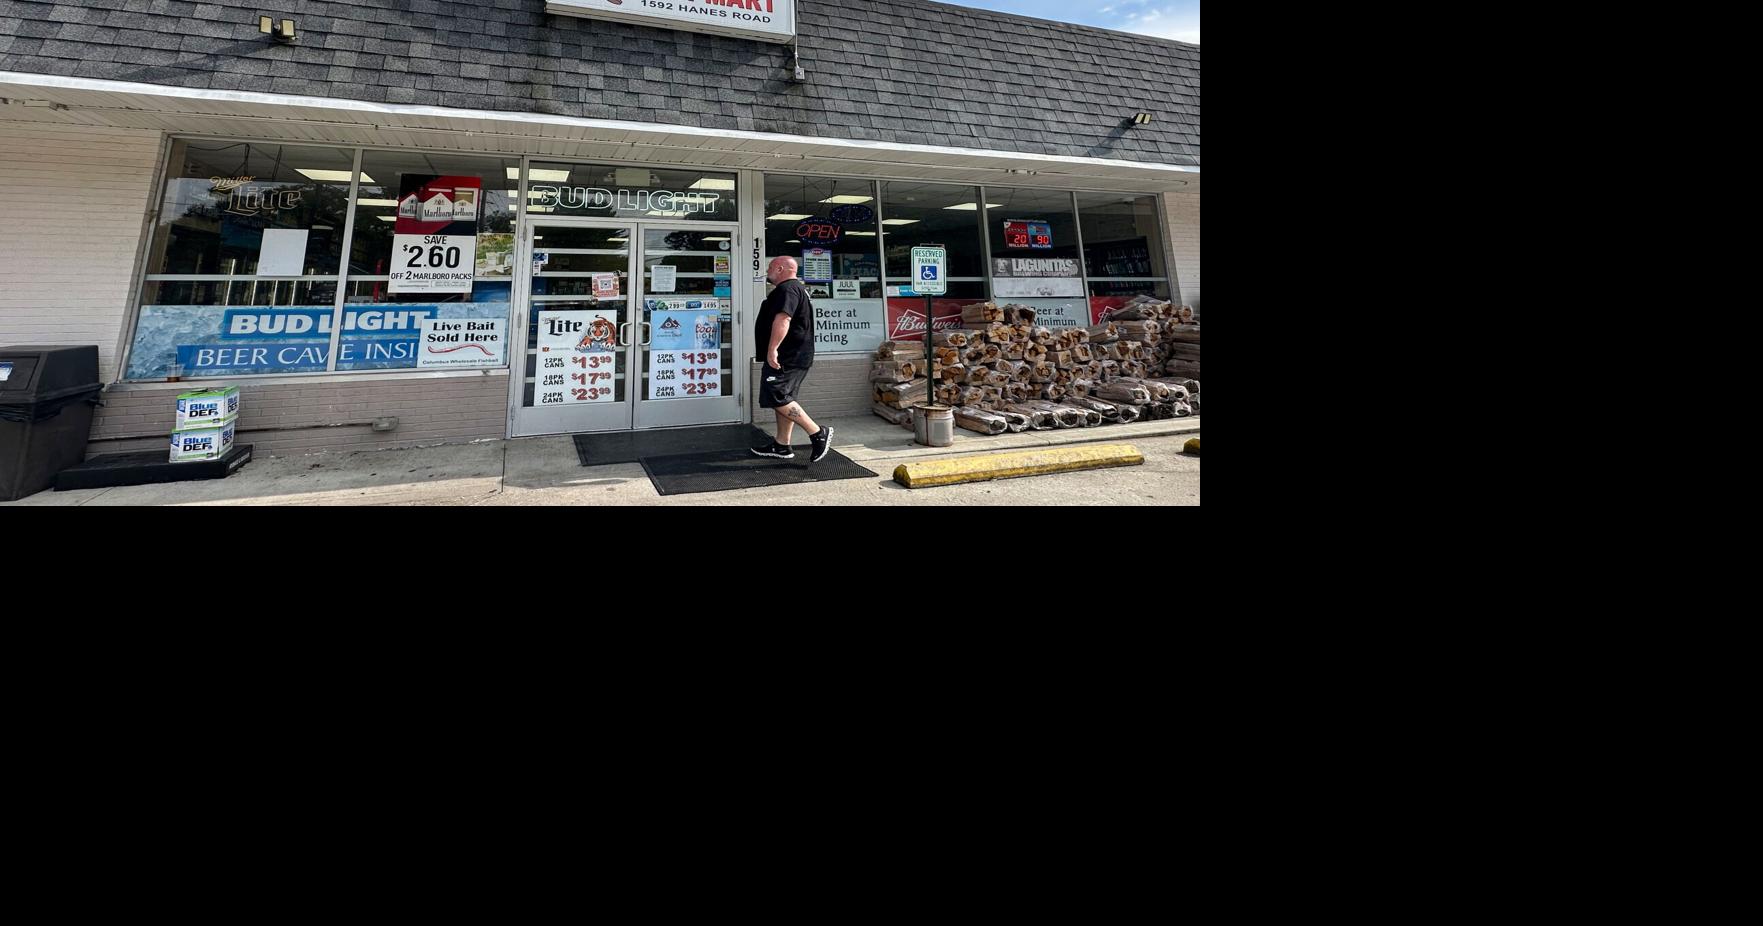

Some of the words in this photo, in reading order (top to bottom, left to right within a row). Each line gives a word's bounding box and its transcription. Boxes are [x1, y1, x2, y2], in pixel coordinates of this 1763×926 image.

[640, 0, 674, 10] 1592
[678, 4, 727, 18] HANES
[732, 12, 771, 23] ROAD
[704, 0, 774, 13] ART
[224, 187, 302, 217] Lite
[531, 185, 613, 209] BUD
[617, 189, 720, 213] LIGHT
[796, 224, 841, 239] OPEN
[424, 236, 448, 245] SAVE
[1013, 234, 1027, 244] 20
[1036, 235, 1050, 244] 90
[402, 245, 461, 269] $2.60
[914, 250, 943, 258] RESERVED
[918, 257, 940, 265] PARKING
[1011, 258, 1074, 272] LAGUNITAS
[405, 271, 411, 280] 2
[451, 272, 472, 280] PACKS
[839, 281, 855, 289] JUUL
[815, 308, 842, 319] Beer
[846, 308, 857, 318] at
[1054, 307, 1064, 316] at
[229, 314, 314, 334] BUD
[433, 322, 462, 332] Live
[467, 321, 495, 331] Bait
[816, 320, 871, 331] Minimum
[1033, 317, 1077, 327] Minimum
[548, 320, 583, 337] Lite
[427, 333, 459, 343] Sold
[465, 333, 499, 343] Here
[814, 333, 849, 346] ricing
[196, 347, 269, 367] BEER
[189, 408, 216, 418] DEF
[182, 443, 209, 452] DEF
